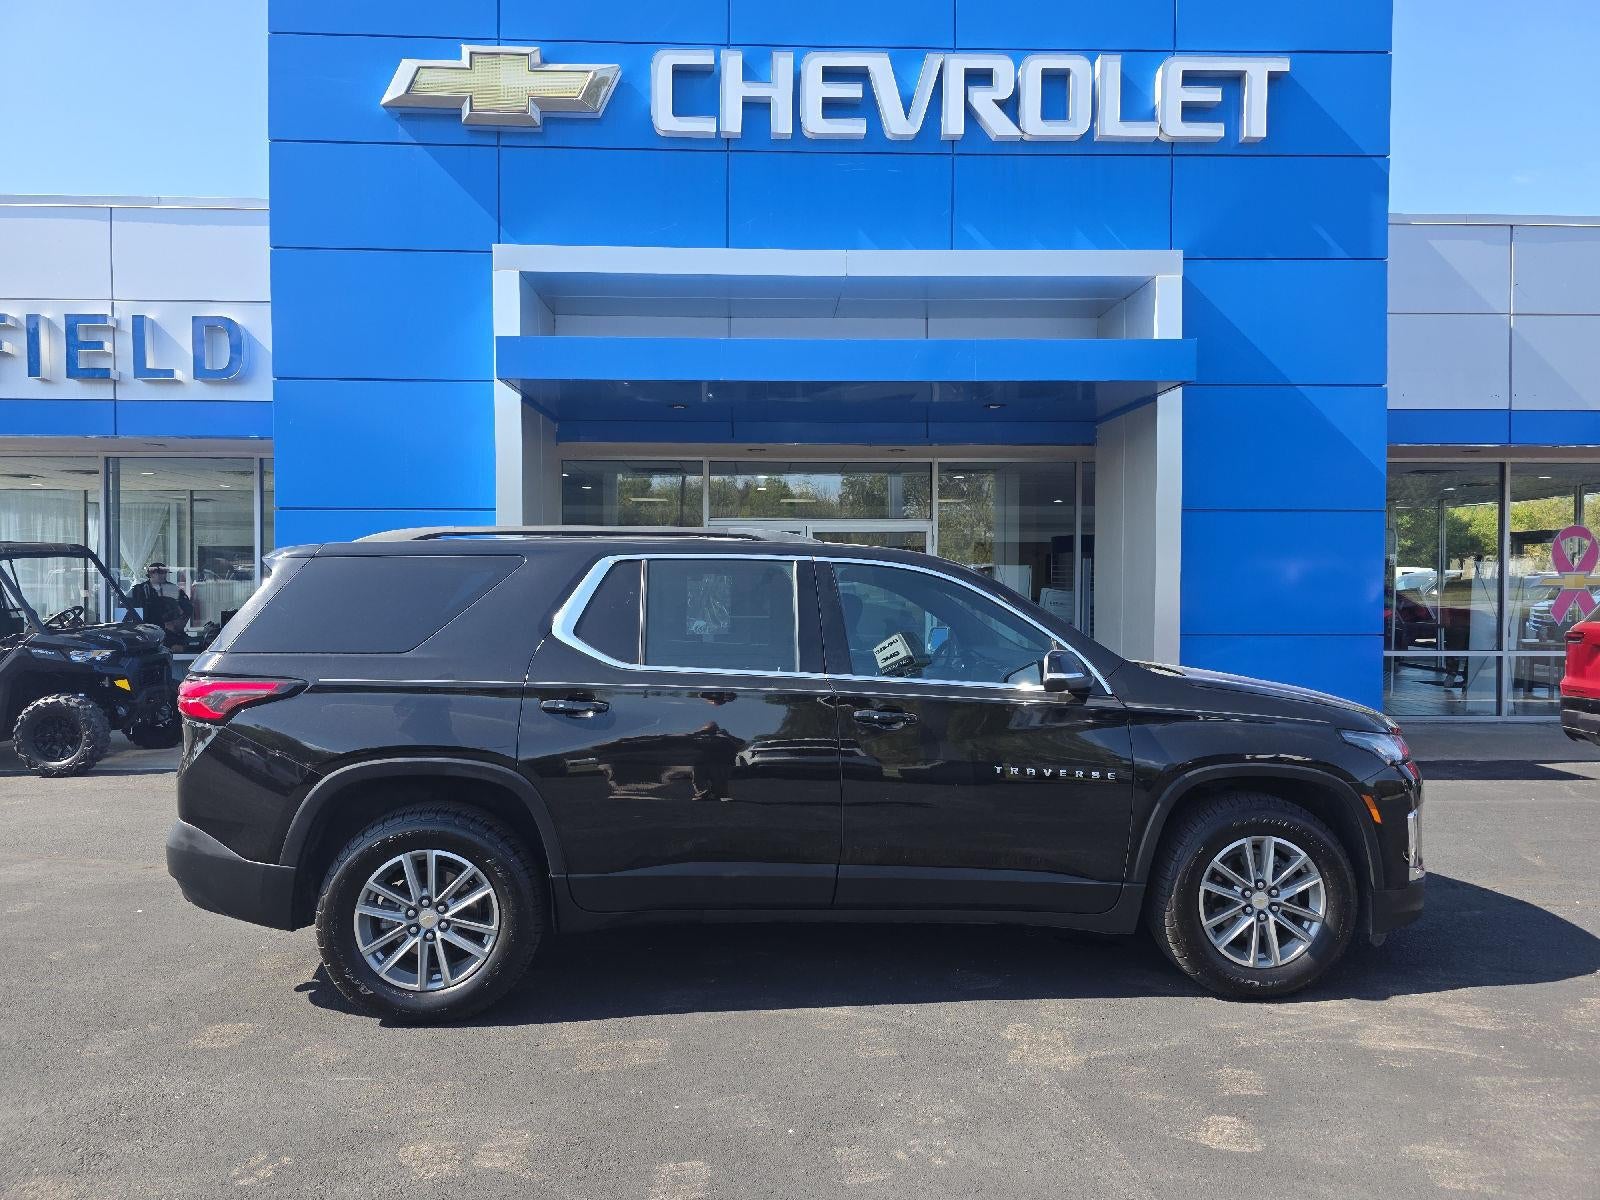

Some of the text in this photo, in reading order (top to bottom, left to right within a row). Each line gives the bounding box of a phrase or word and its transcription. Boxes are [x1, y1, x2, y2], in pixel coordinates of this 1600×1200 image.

[651, 50, 1290, 142] CHEVROLET
[0, 313, 245, 380] IELD
[994, 765, 1116, 780] TRAVERSE
